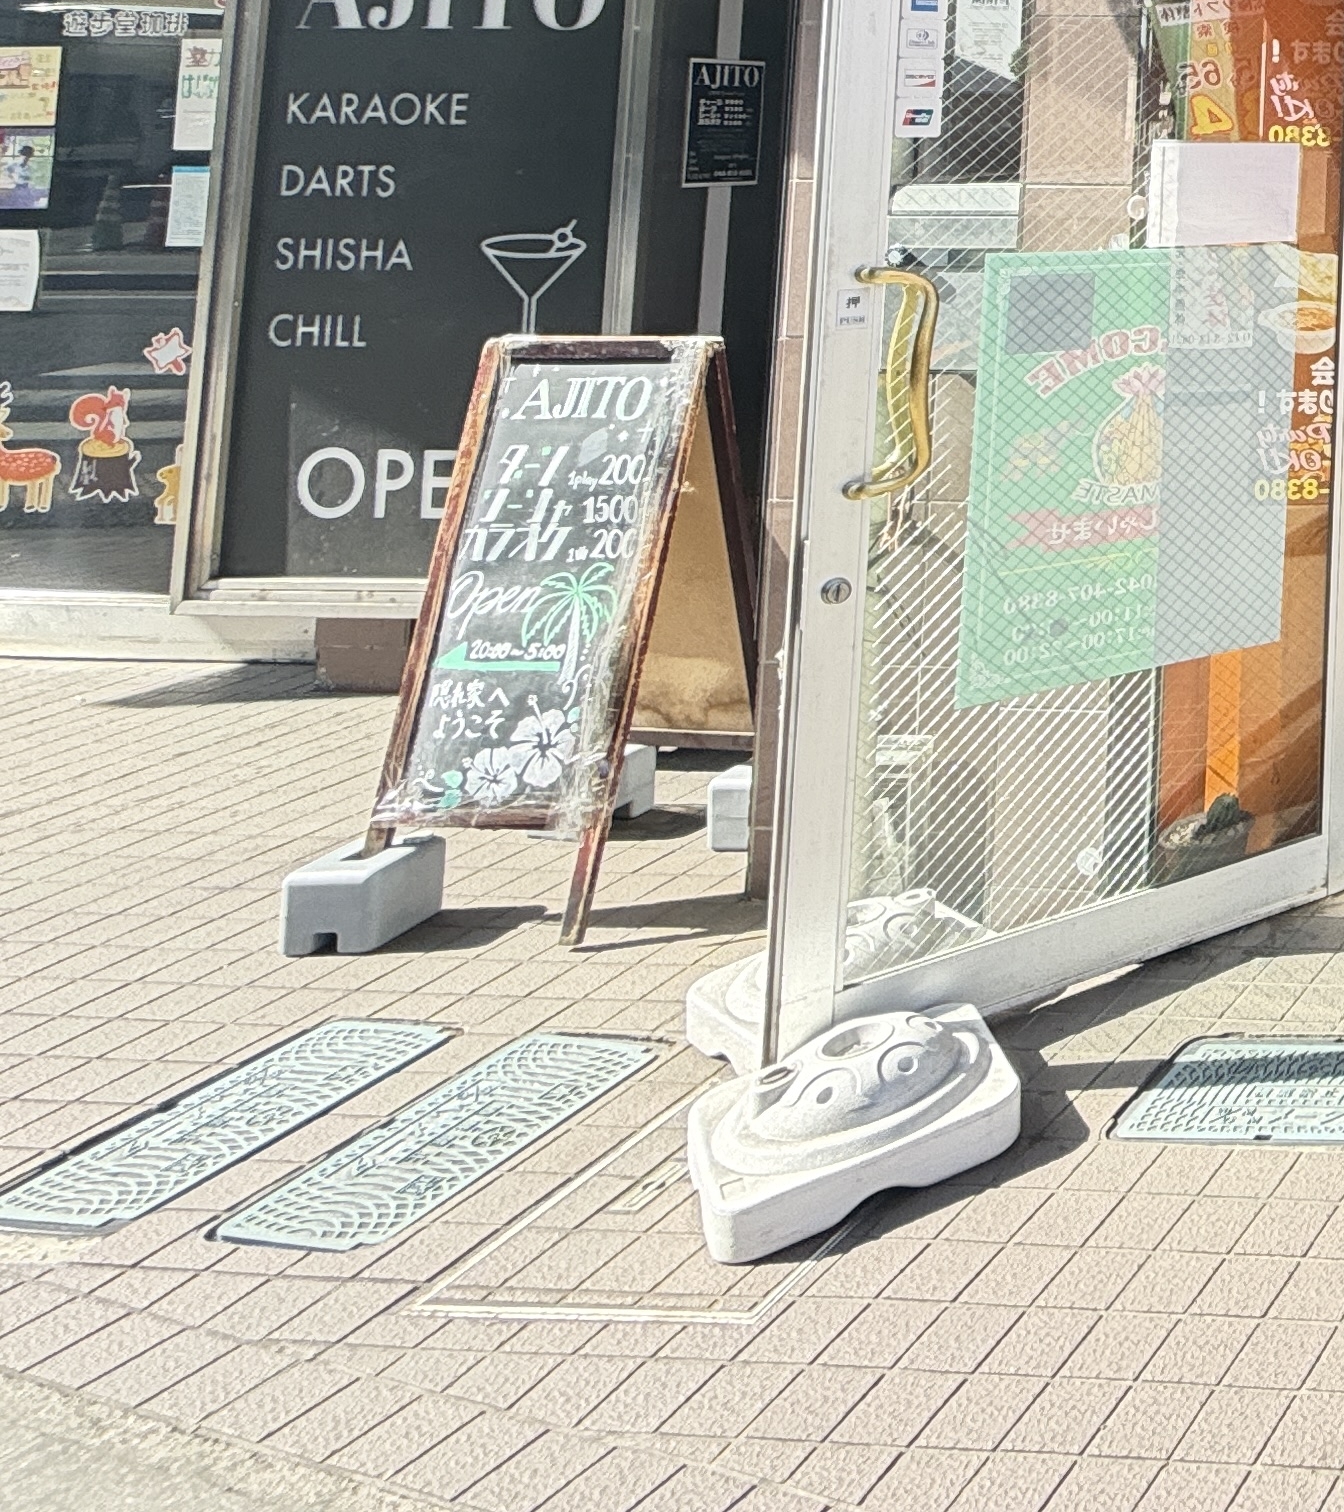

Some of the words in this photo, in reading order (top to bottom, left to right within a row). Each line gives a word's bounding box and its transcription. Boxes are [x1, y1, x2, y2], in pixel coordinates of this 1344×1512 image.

[694, 65, 760, 89] AJITO
[286, 91, 469, 127] KARAOKE
[280, 164, 397, 198] DARTS
[275, 237, 413, 272] SHISHA
[268, 313, 367, 349] CHILL
[511, 376, 652, 421] AJITO
[296, 447, 453, 520] OPE
[447, 571, 542, 640] Open
[433, 710, 505, 739] ようこそ
